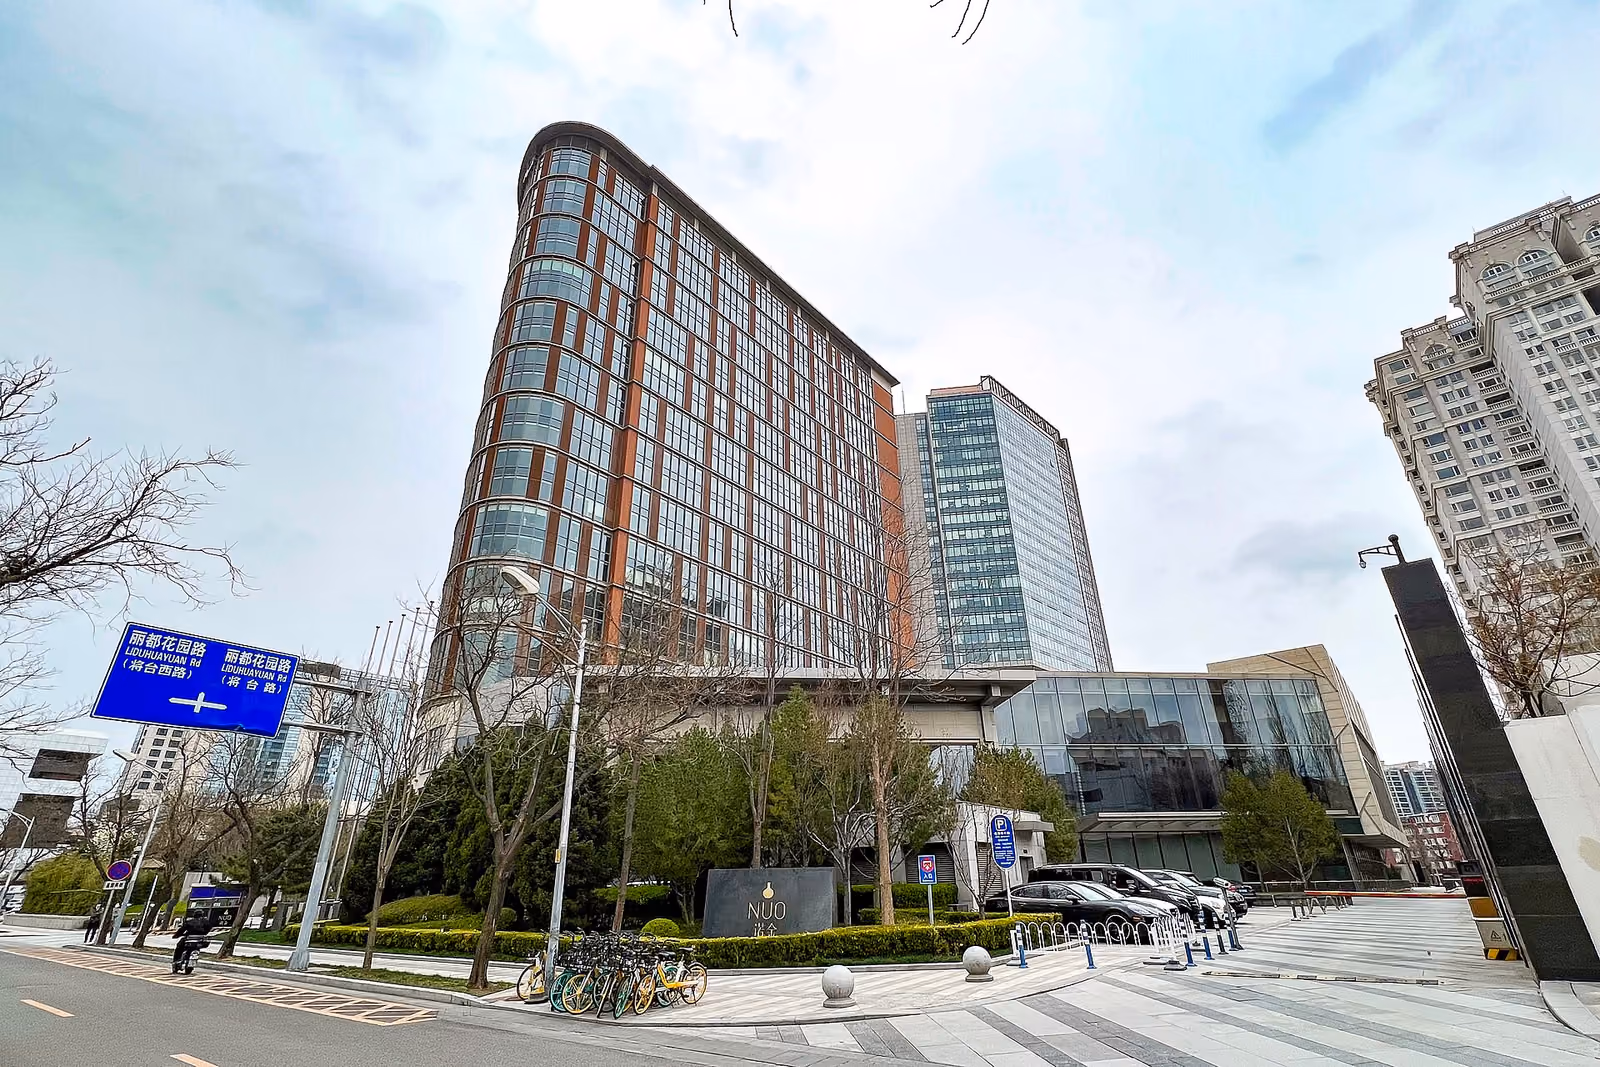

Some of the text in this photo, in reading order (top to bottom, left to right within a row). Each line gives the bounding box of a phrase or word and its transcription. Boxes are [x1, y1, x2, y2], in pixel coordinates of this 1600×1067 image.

[129, 630, 207, 658] 丽都花园路
[125, 646, 202, 668] LIDUHUAYUAN Rd
[224, 648, 292, 674] 丽都花园路
[221, 664, 287, 683] LIDUHUAYUAN Rd
[747, 901, 786, 920] NUO
